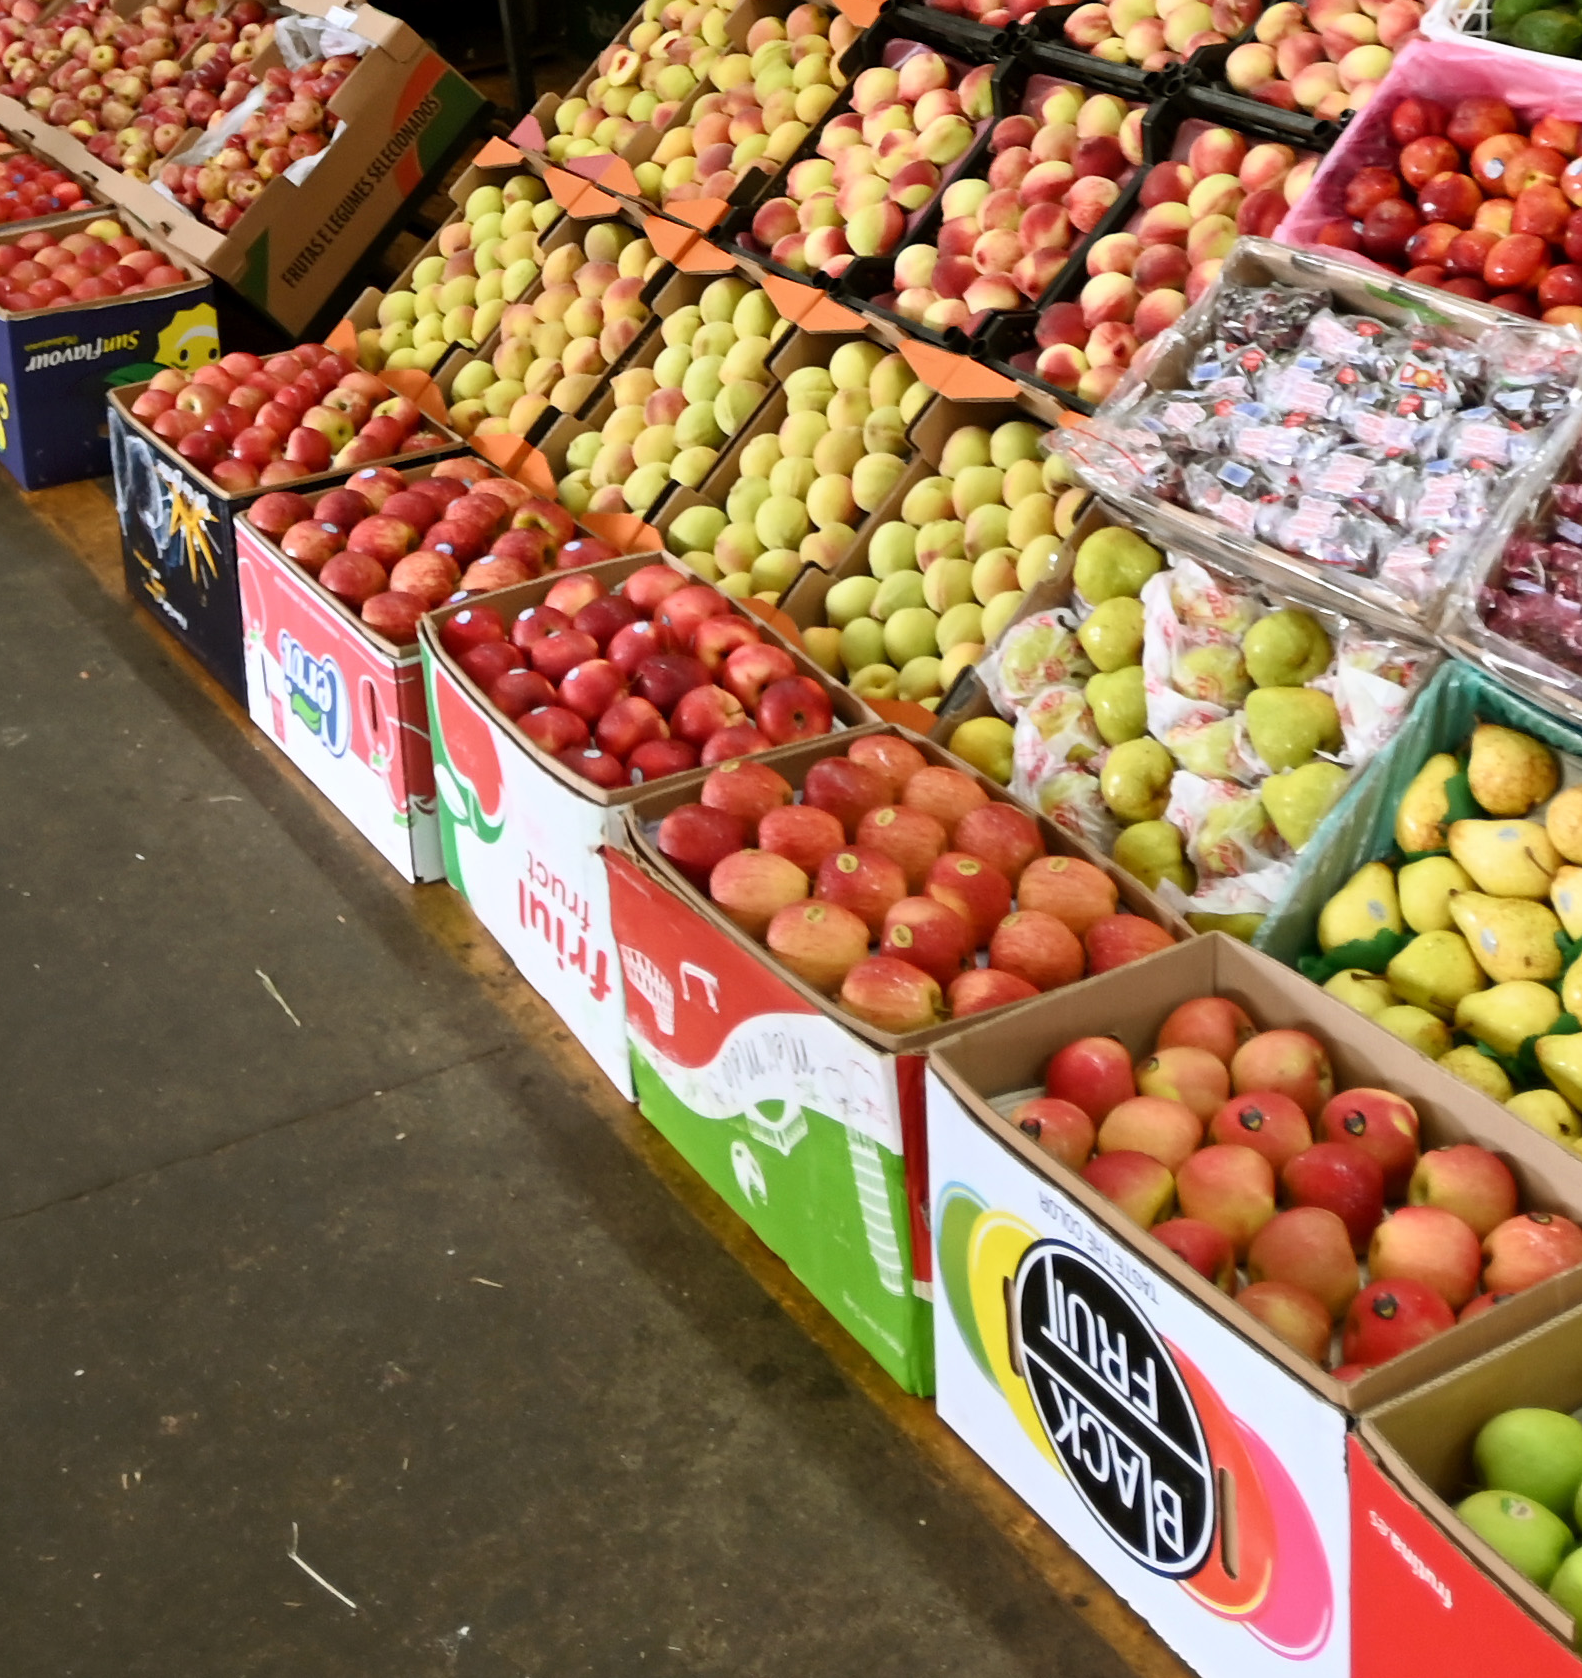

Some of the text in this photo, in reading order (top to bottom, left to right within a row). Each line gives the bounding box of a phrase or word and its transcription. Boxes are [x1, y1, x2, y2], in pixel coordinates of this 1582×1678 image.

[281, 94, 440, 290] FRUTAS E LEGUMES SELECIONADOS
[24, 329, 141, 373] Sunflavour
[518, 878, 612, 1003] friul
[526, 850, 591, 933] fruct
[1038, 1190, 1160, 1307] TASTE THE COLOR
[1039, 1252, 1161, 1424] FRUIT
[1048, 1379, 1187, 1562] BLACK
